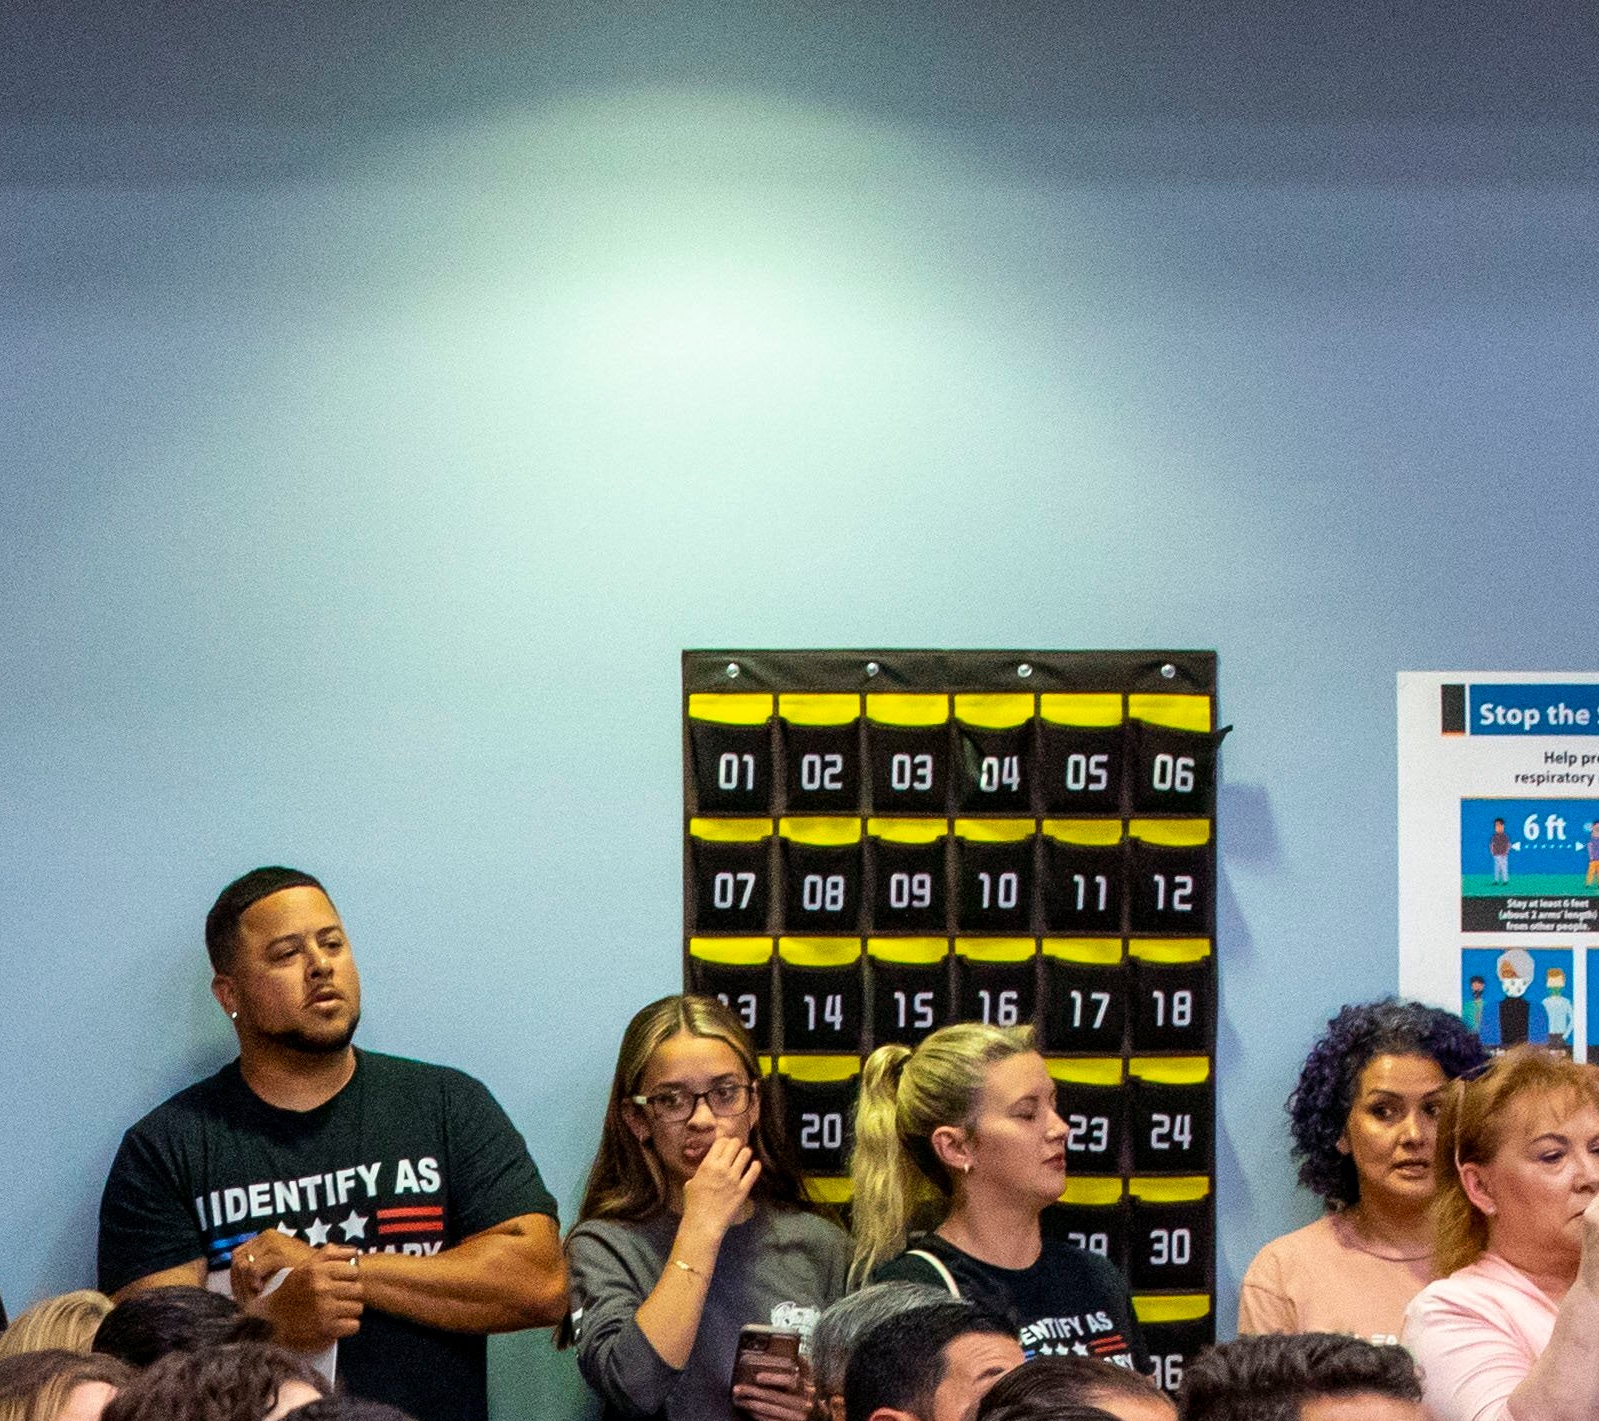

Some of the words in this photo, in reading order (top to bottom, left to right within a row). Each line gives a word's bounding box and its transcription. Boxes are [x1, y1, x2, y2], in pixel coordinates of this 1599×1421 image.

[1479, 703, 1541, 730] Stop
[1547, 704, 1590, 725] the
[718, 753, 754, 790] 01
[802, 754, 843, 790] 02
[891, 754, 933, 790] 03
[981, 756, 1020, 792] 04
[1066, 754, 1108, 791] 05
[1154, 754, 1195, 792] 06
[1544, 751, 1577, 767] Help
[1515, 772, 1594, 786] respiratory
[1524, 814, 1540, 841] 6
[1545, 814, 1567, 841] ft
[714, 873, 756, 909] 07
[803, 874, 845, 911] 08
[889, 873, 932, 909] 09
[979, 872, 1018, 909] 10
[1073, 874, 1106, 910] 11
[1154, 875, 1193, 911] 12
[1507, 898, 1527, 909] Stay
[1528, 900, 1538, 908] at
[1539, 899, 1562, 908] least
[1571, 899, 1589, 908] feet
[1506, 921, 1528, 930] from
[1529, 922, 1555, 930] other
[804, 995, 844, 1031] 14
[894, 992, 933, 1028] 15
[979, 990, 1018, 1026] 16
[1070, 992, 1110, 1029] 17
[1153, 990, 1192, 1027] 18
[801, 1113, 842, 1149] 20
[1067, 1114, 1108, 1151] 23
[1151, 1114, 1192, 1151] 24
[209, 1161, 381, 1227] IDENTIFY
[394, 1156, 441, 1195] AS
[1150, 1228, 1191, 1264] 30
[1020, 1315, 1084, 1346] ENTIFY
[1086, 1311, 1113, 1333] AS
